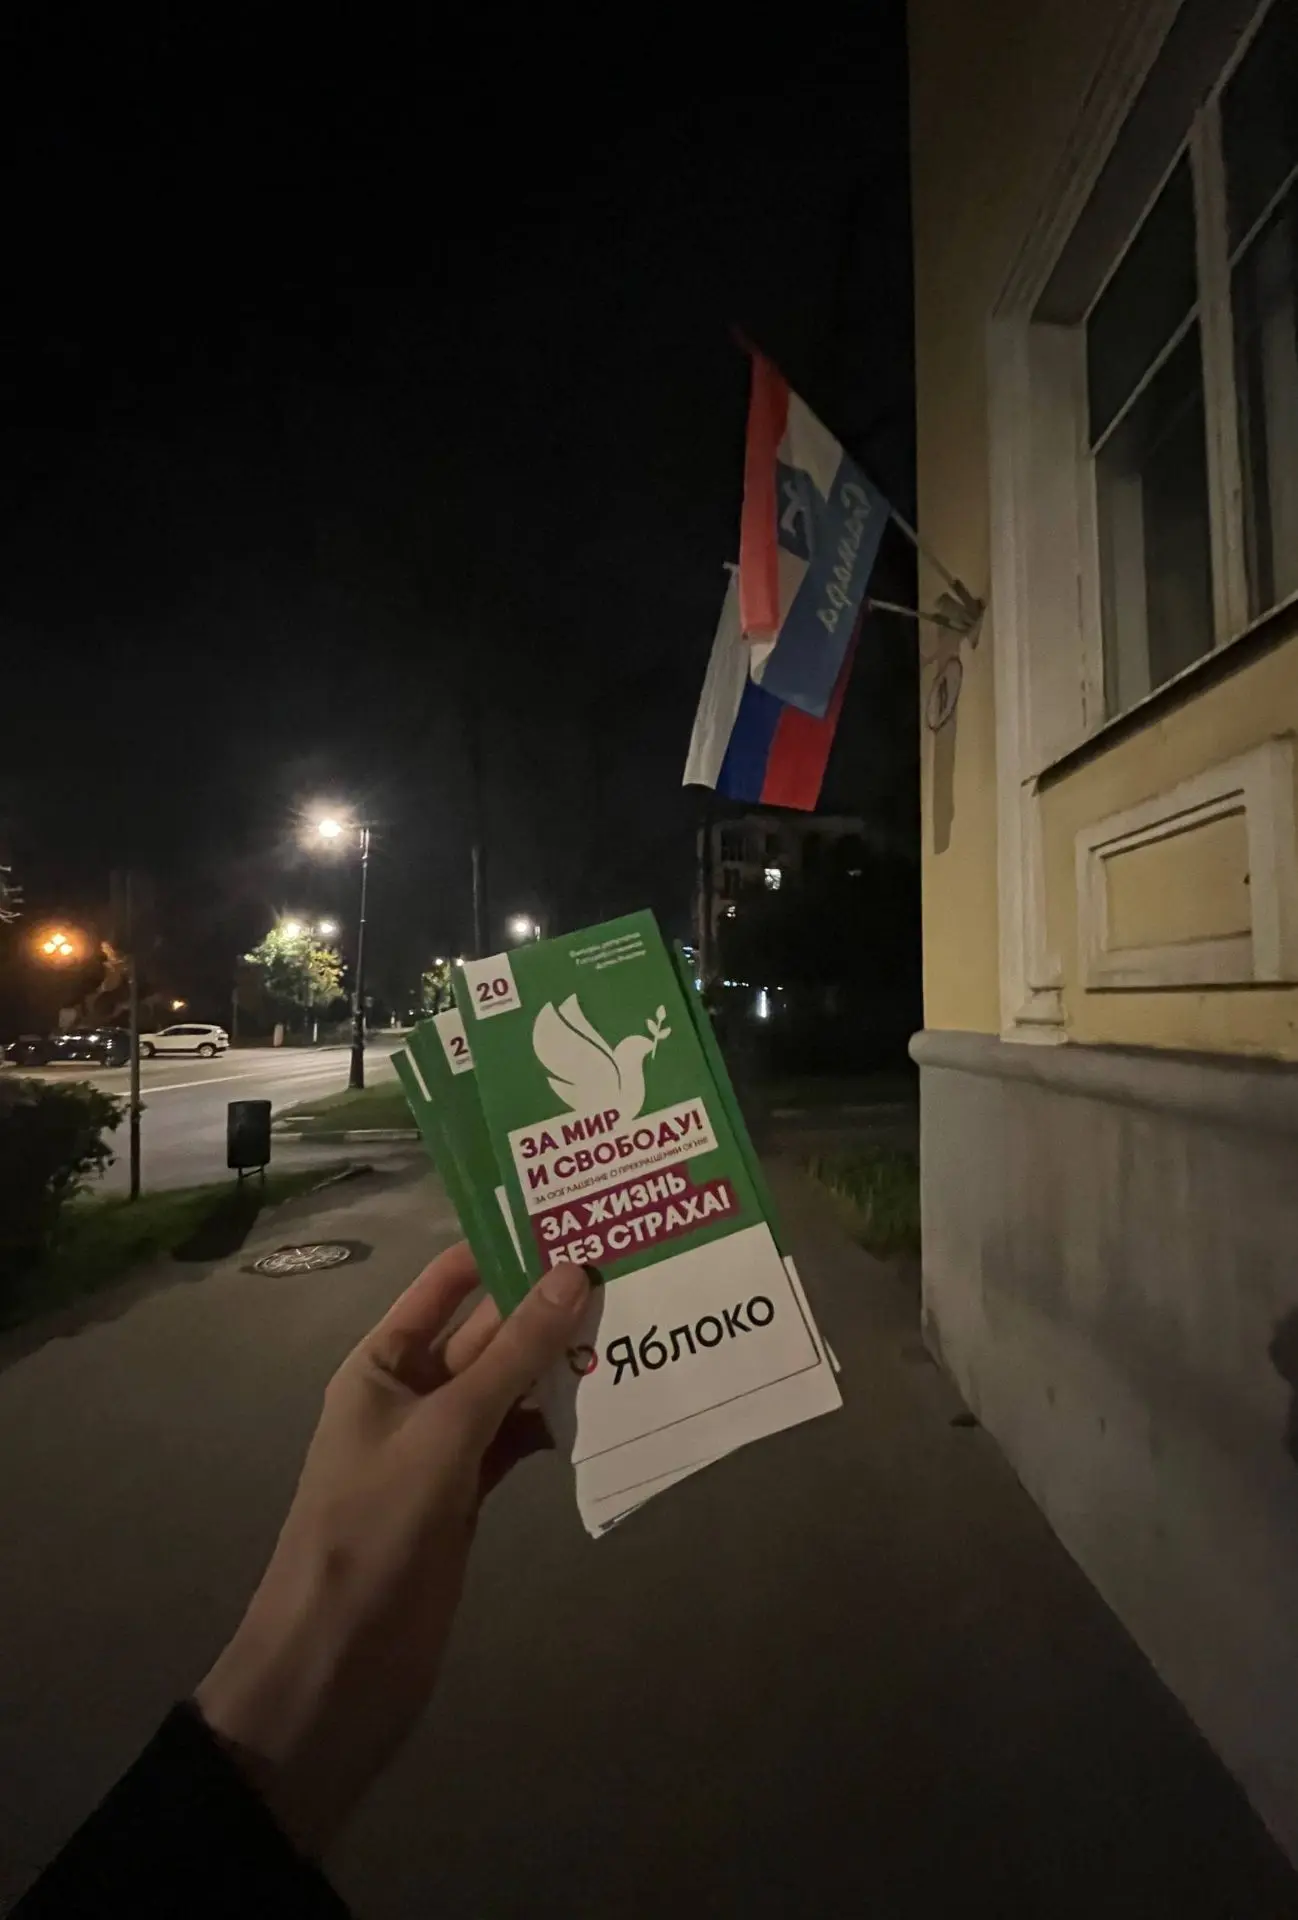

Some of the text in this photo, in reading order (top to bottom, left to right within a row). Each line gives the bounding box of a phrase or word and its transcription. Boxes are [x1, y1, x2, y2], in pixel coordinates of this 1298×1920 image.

[476, 978, 509, 1003] 20
[450, 1036, 468, 1057] 2
[519, 1108, 620, 1159] ЗА МИР
[527, 1109, 703, 1189] И СВОБОДУ!
[539, 1171, 687, 1241] ЗА ЖИЗНЬ
[548, 1185, 732, 1267] БЕЗ СТРАХА!
